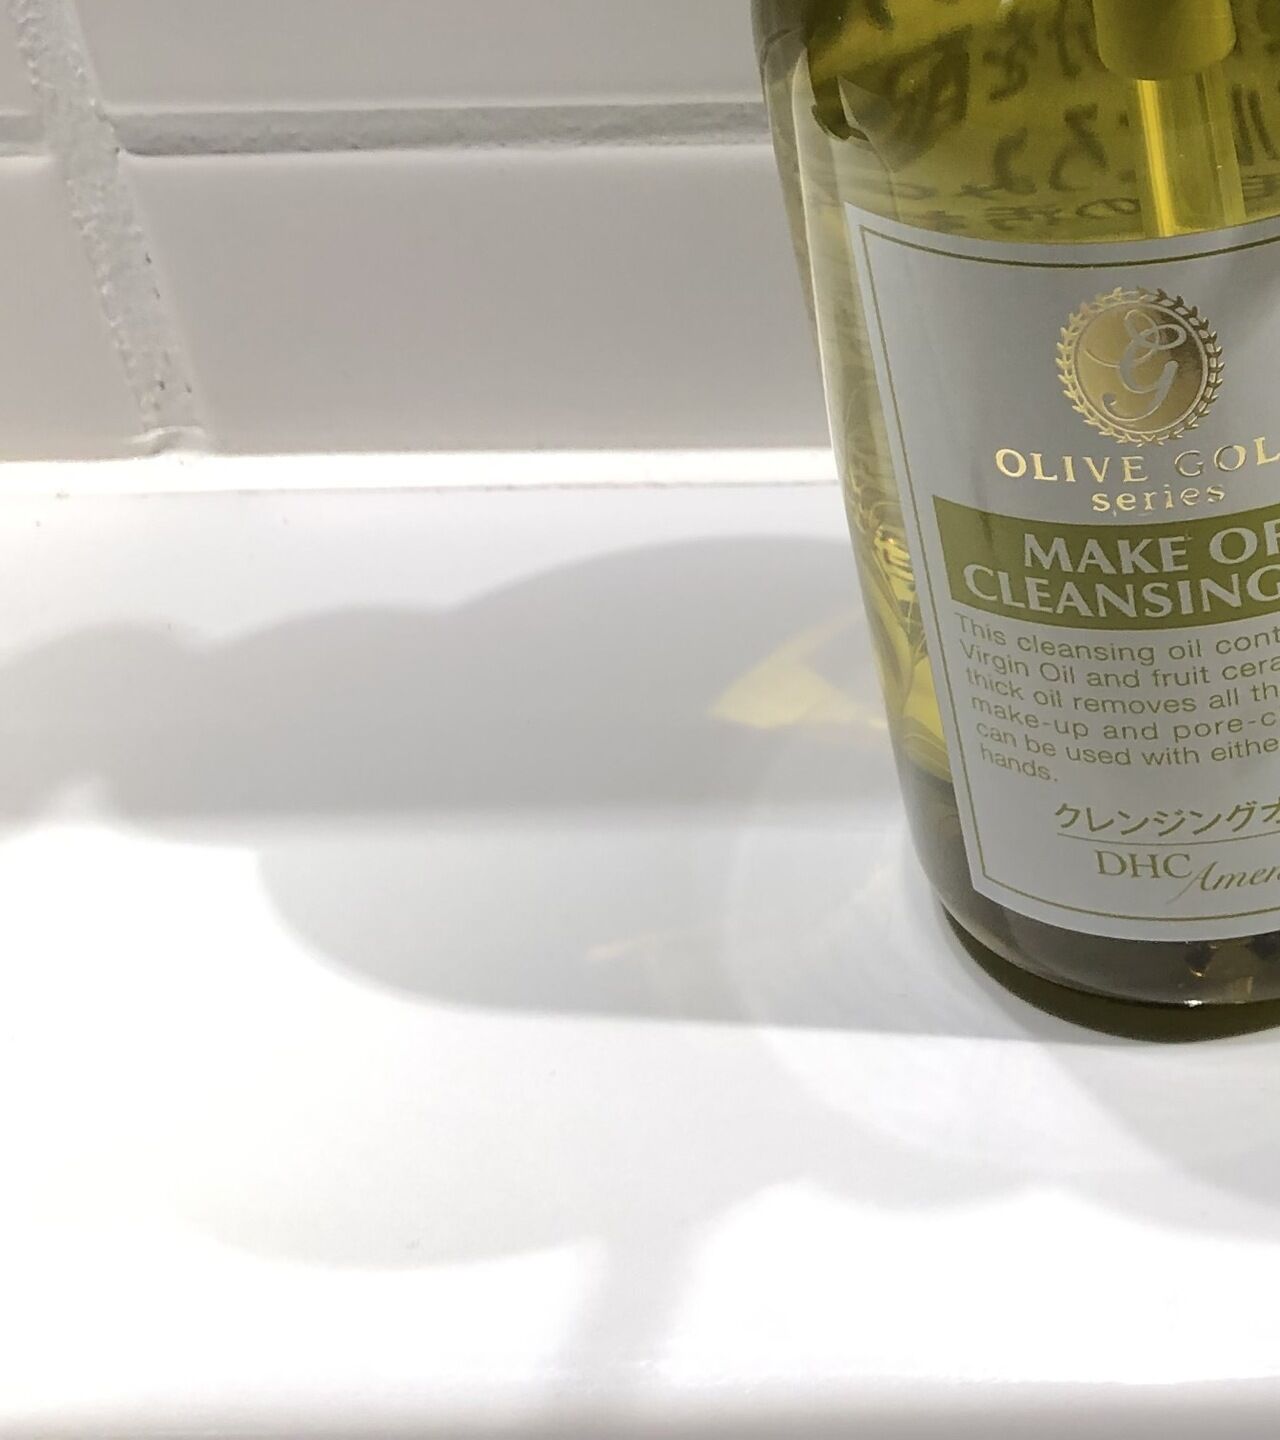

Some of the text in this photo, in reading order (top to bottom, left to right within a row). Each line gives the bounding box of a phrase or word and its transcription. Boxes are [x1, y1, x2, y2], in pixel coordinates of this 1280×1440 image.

[994, 448, 1148, 483] OLIVE
[1092, 482, 1226, 513] series
[1023, 532, 1190, 575] MAKE
[954, 612, 1007, 646] This
[1017, 635, 1155, 667] cleansing
[1168, 639, 1202, 661] oil
[959, 639, 1030, 676] Virgin
[1040, 662, 1076, 684] Oil
[1087, 669, 1141, 688] and
[1153, 666, 1210, 687] fruit
[966, 667, 1024, 701] thick
[1033, 690, 1063, 708] oil
[1073, 696, 1197, 714] removes
[1208, 688, 1239, 710] all
[971, 696, 1089, 741] make-up
[1103, 723, 1159, 741] and
[976, 722, 1017, 747] can
[1025, 734, 1057, 757] be
[1065, 746, 1132, 766] used
[1142, 741, 1200, 766] with
[979, 743, 1059, 782] hands.
[1096, 849, 1195, 880] DHC
